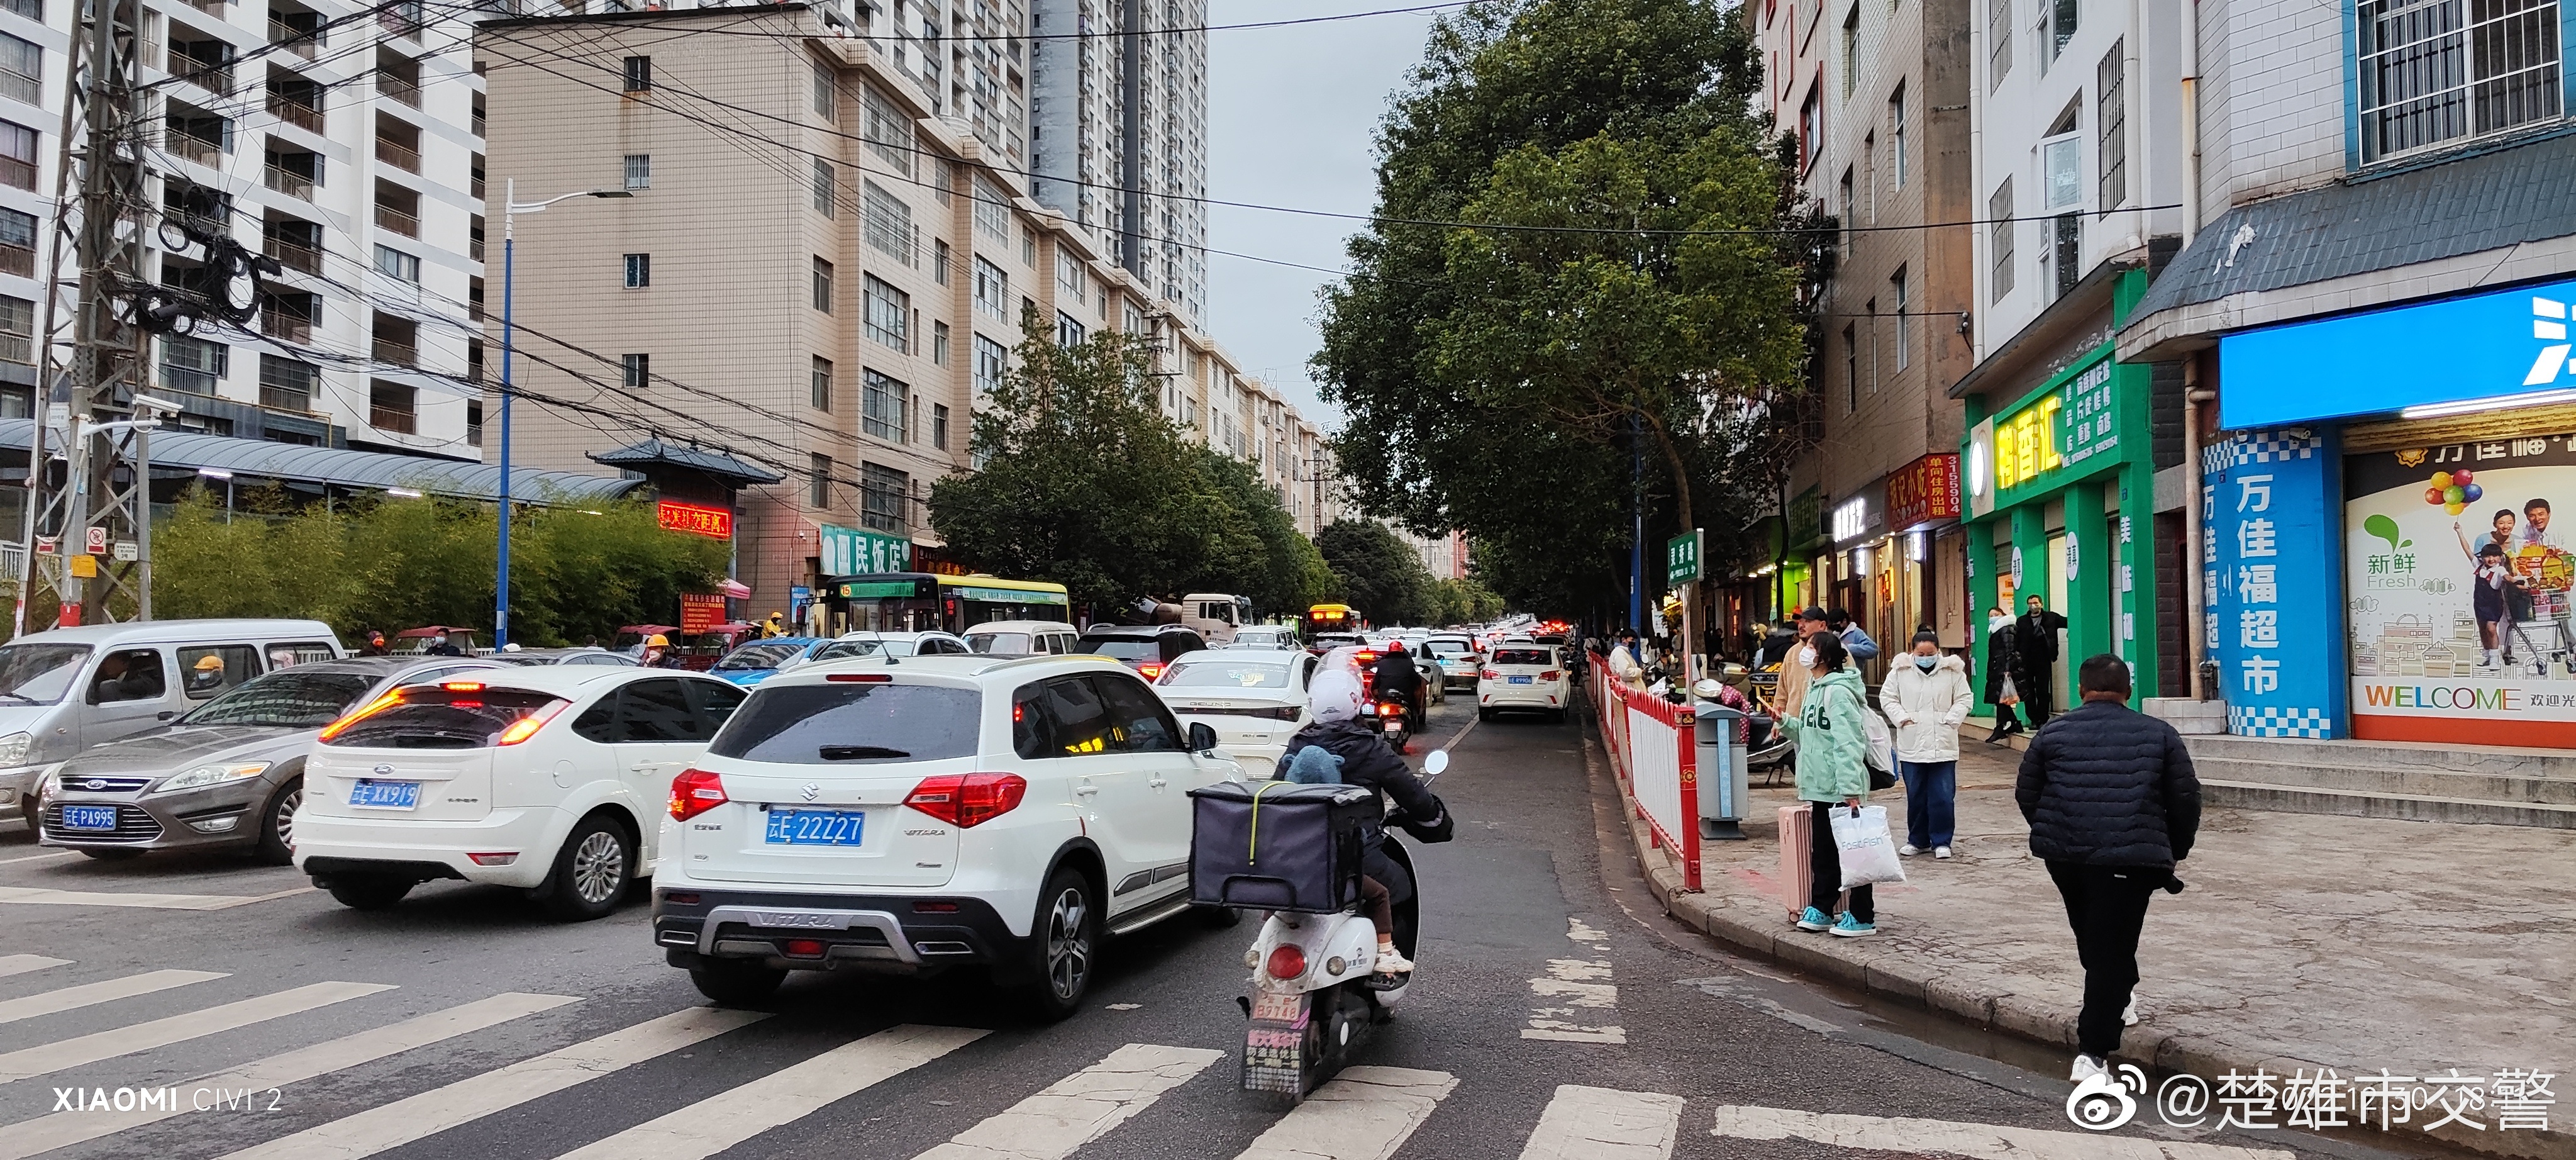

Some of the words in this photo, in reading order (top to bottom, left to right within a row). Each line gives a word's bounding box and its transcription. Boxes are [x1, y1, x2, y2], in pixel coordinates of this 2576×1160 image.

[1998, 396, 2062, 489] 鸭香汇
[1929, 457, 1946, 516] 单间住房出租
[1948, 456, 1960, 513] 3155904
[837, 535, 901, 575] 回民饭店
[2368, 553, 2416, 574] 新鲜
[841, 586, 850, 595] 15
[2236, 474, 2280, 695] 万佳福超市
[2367, 575, 2416, 588] Fresh
[2365, 685, 2522, 711] WELCOME
